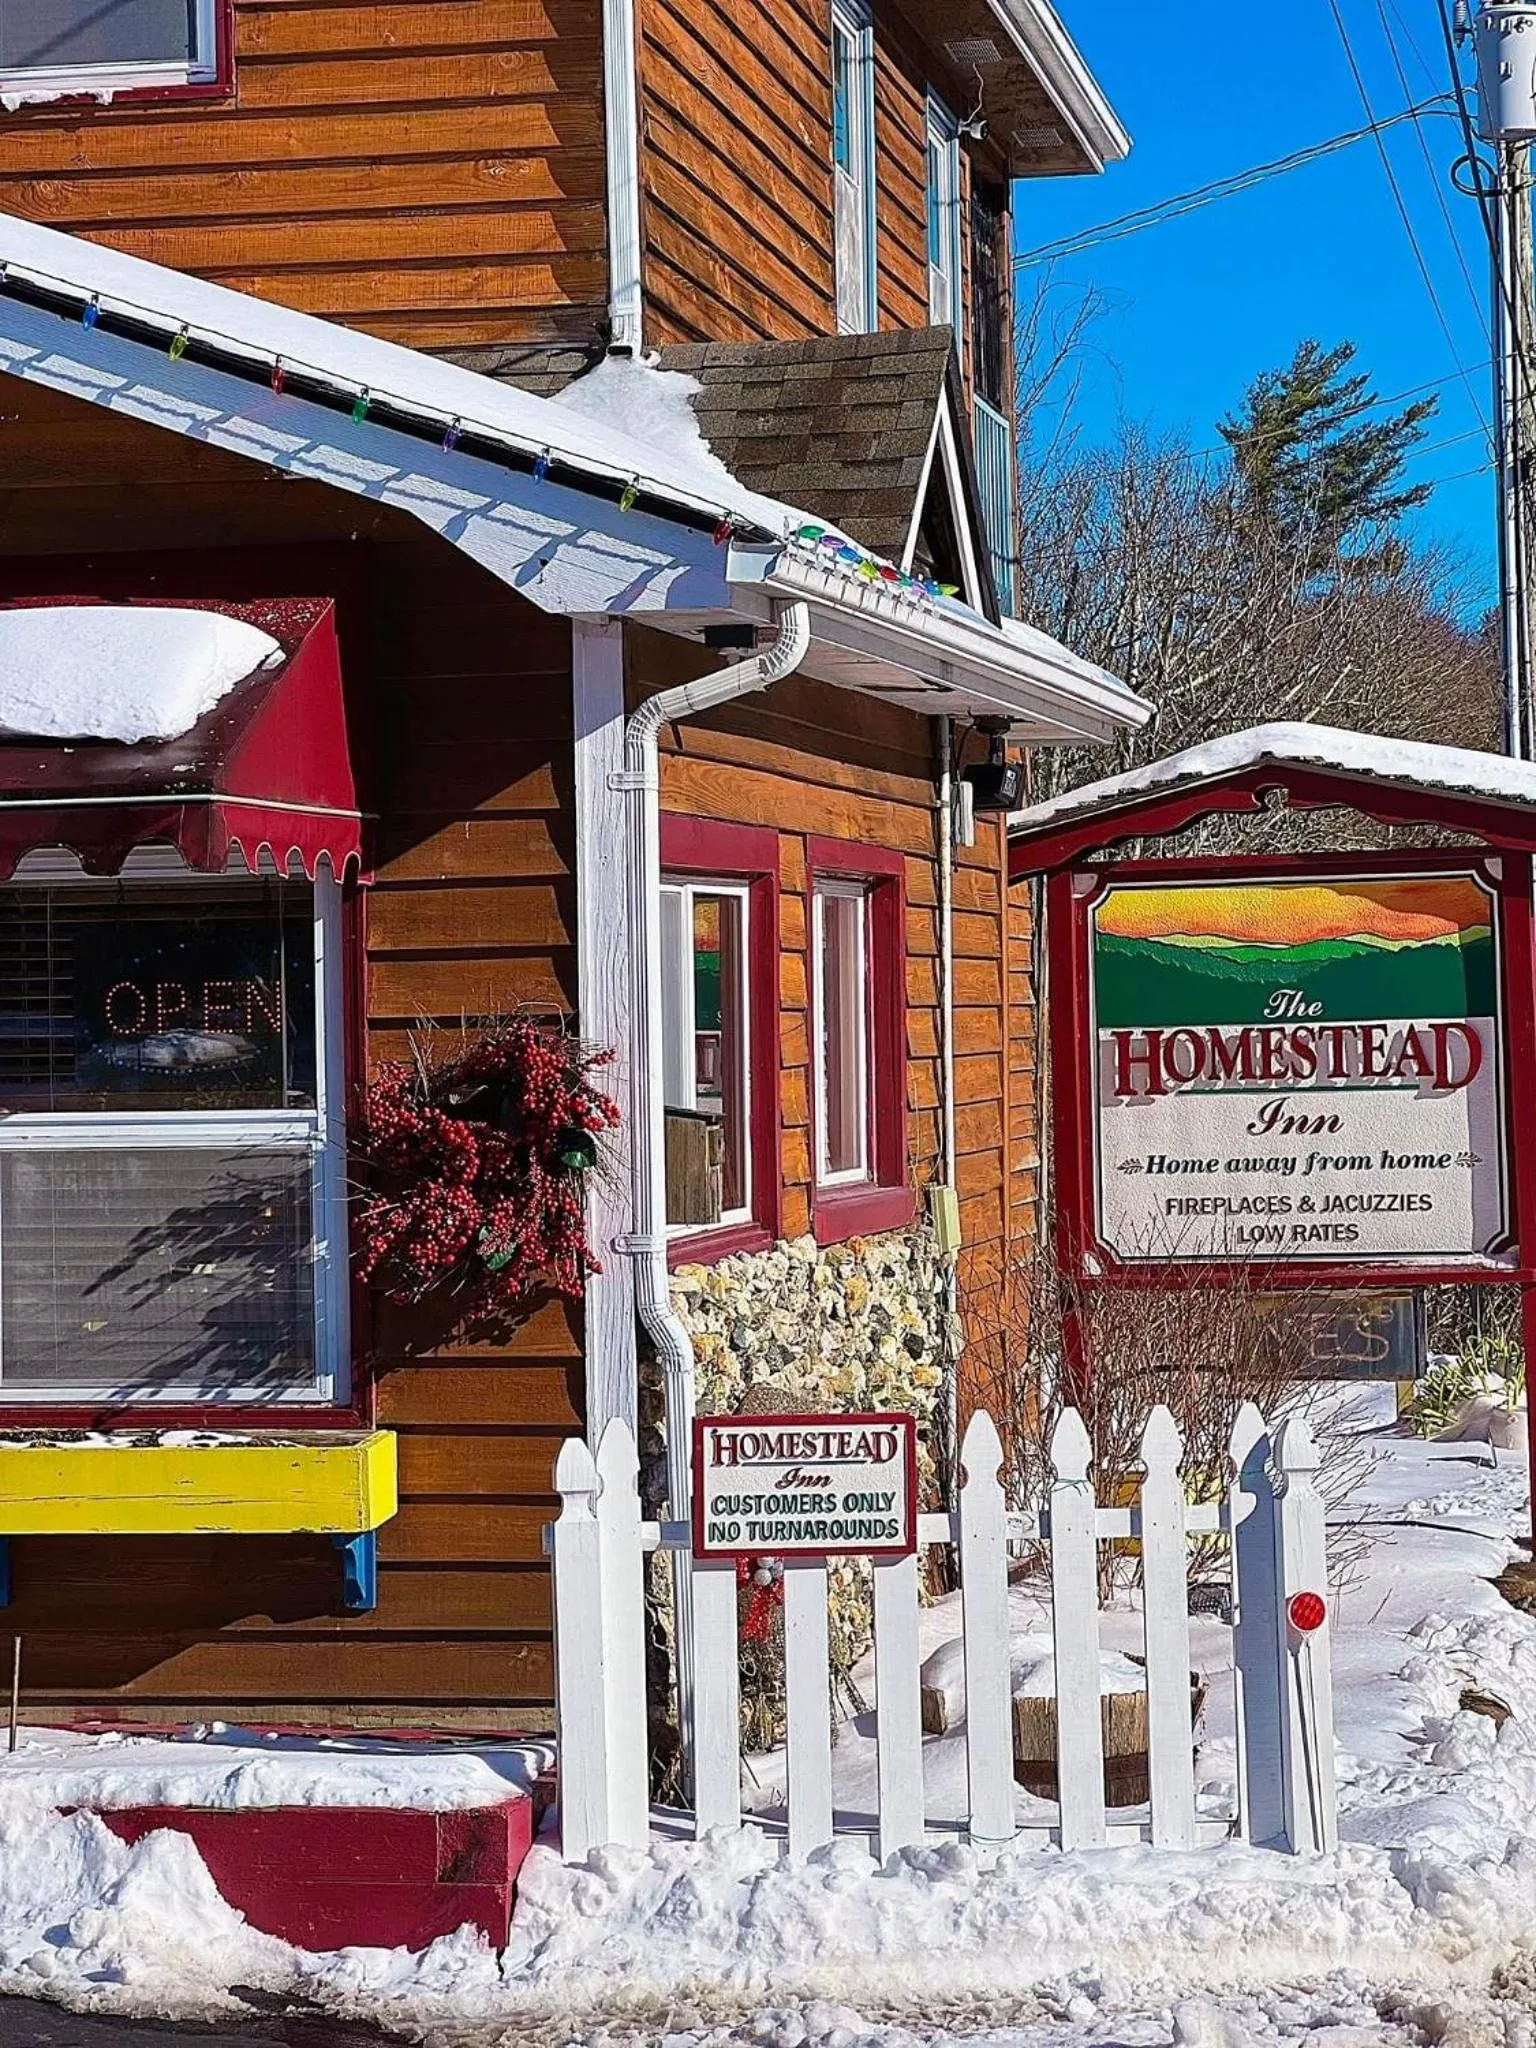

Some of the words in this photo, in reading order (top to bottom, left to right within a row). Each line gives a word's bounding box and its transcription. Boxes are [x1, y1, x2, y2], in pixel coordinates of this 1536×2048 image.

[106, 981, 281, 1033] OPEN
[1263, 989, 1324, 1018] The
[1110, 1022, 1482, 1097] HOMESTEAD
[1246, 1097, 1345, 1136] Inn
[1145, 1154, 1219, 1175] Home
[1224, 1154, 1297, 1176] away
[1301, 1151, 1373, 1176] from
[1379, 1150, 1451, 1170] home
[1165, 1195, 1292, 1216] FIREPLACES
[1300, 1195, 1316, 1213] &
[1319, 1193, 1433, 1213] JACUZZIES
[1236, 1224, 1287, 1244] LOW
[1290, 1223, 1360, 1242] RATES
[710, 1430, 898, 1468] HOMESTEAD
[774, 1467, 834, 1490] Inn
[710, 1492, 837, 1516] CUSTOMERS
[842, 1491, 896, 1514] ONLY
[708, 1520, 741, 1543] NO
[746, 1518, 899, 1542] TURNAROUNDS
